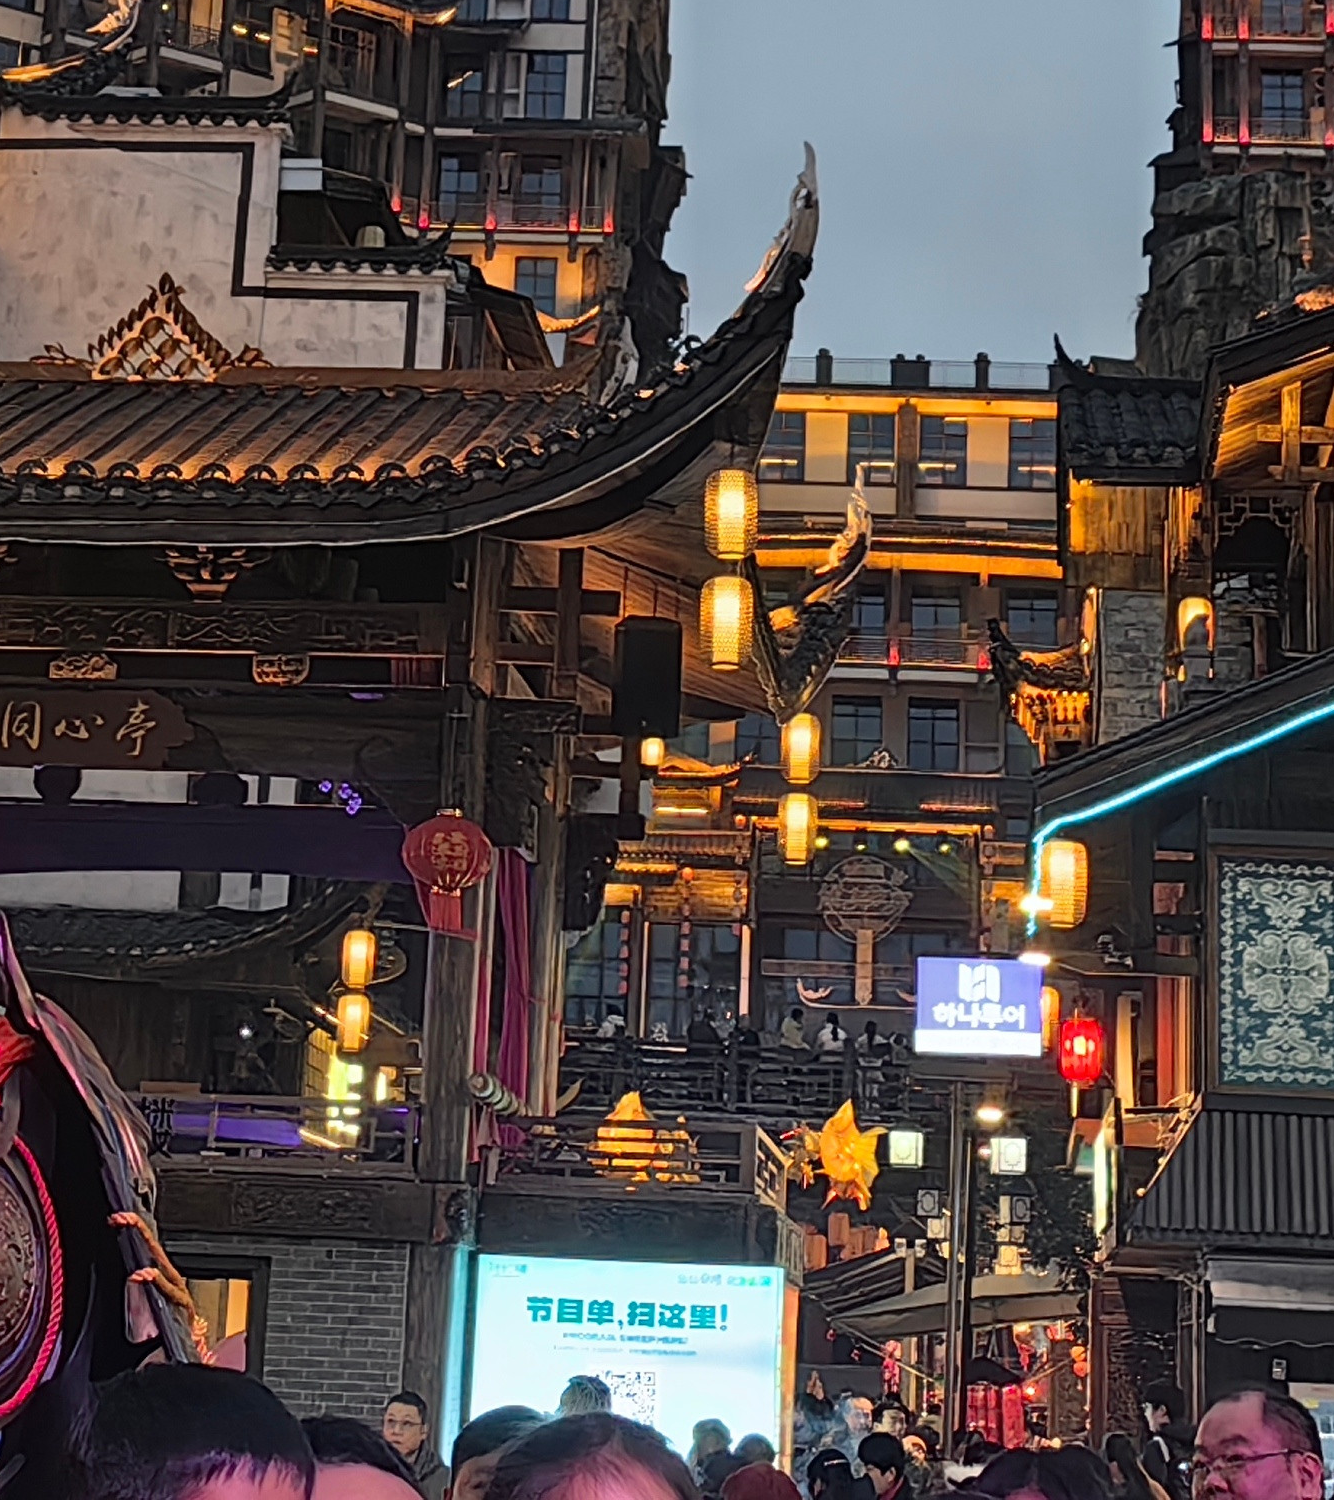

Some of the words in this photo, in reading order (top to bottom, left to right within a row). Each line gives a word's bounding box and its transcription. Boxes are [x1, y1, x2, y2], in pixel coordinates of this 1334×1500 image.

[0, 697, 157, 756] 同心亭
[931, 1002, 1026, 1030] 하나투어
